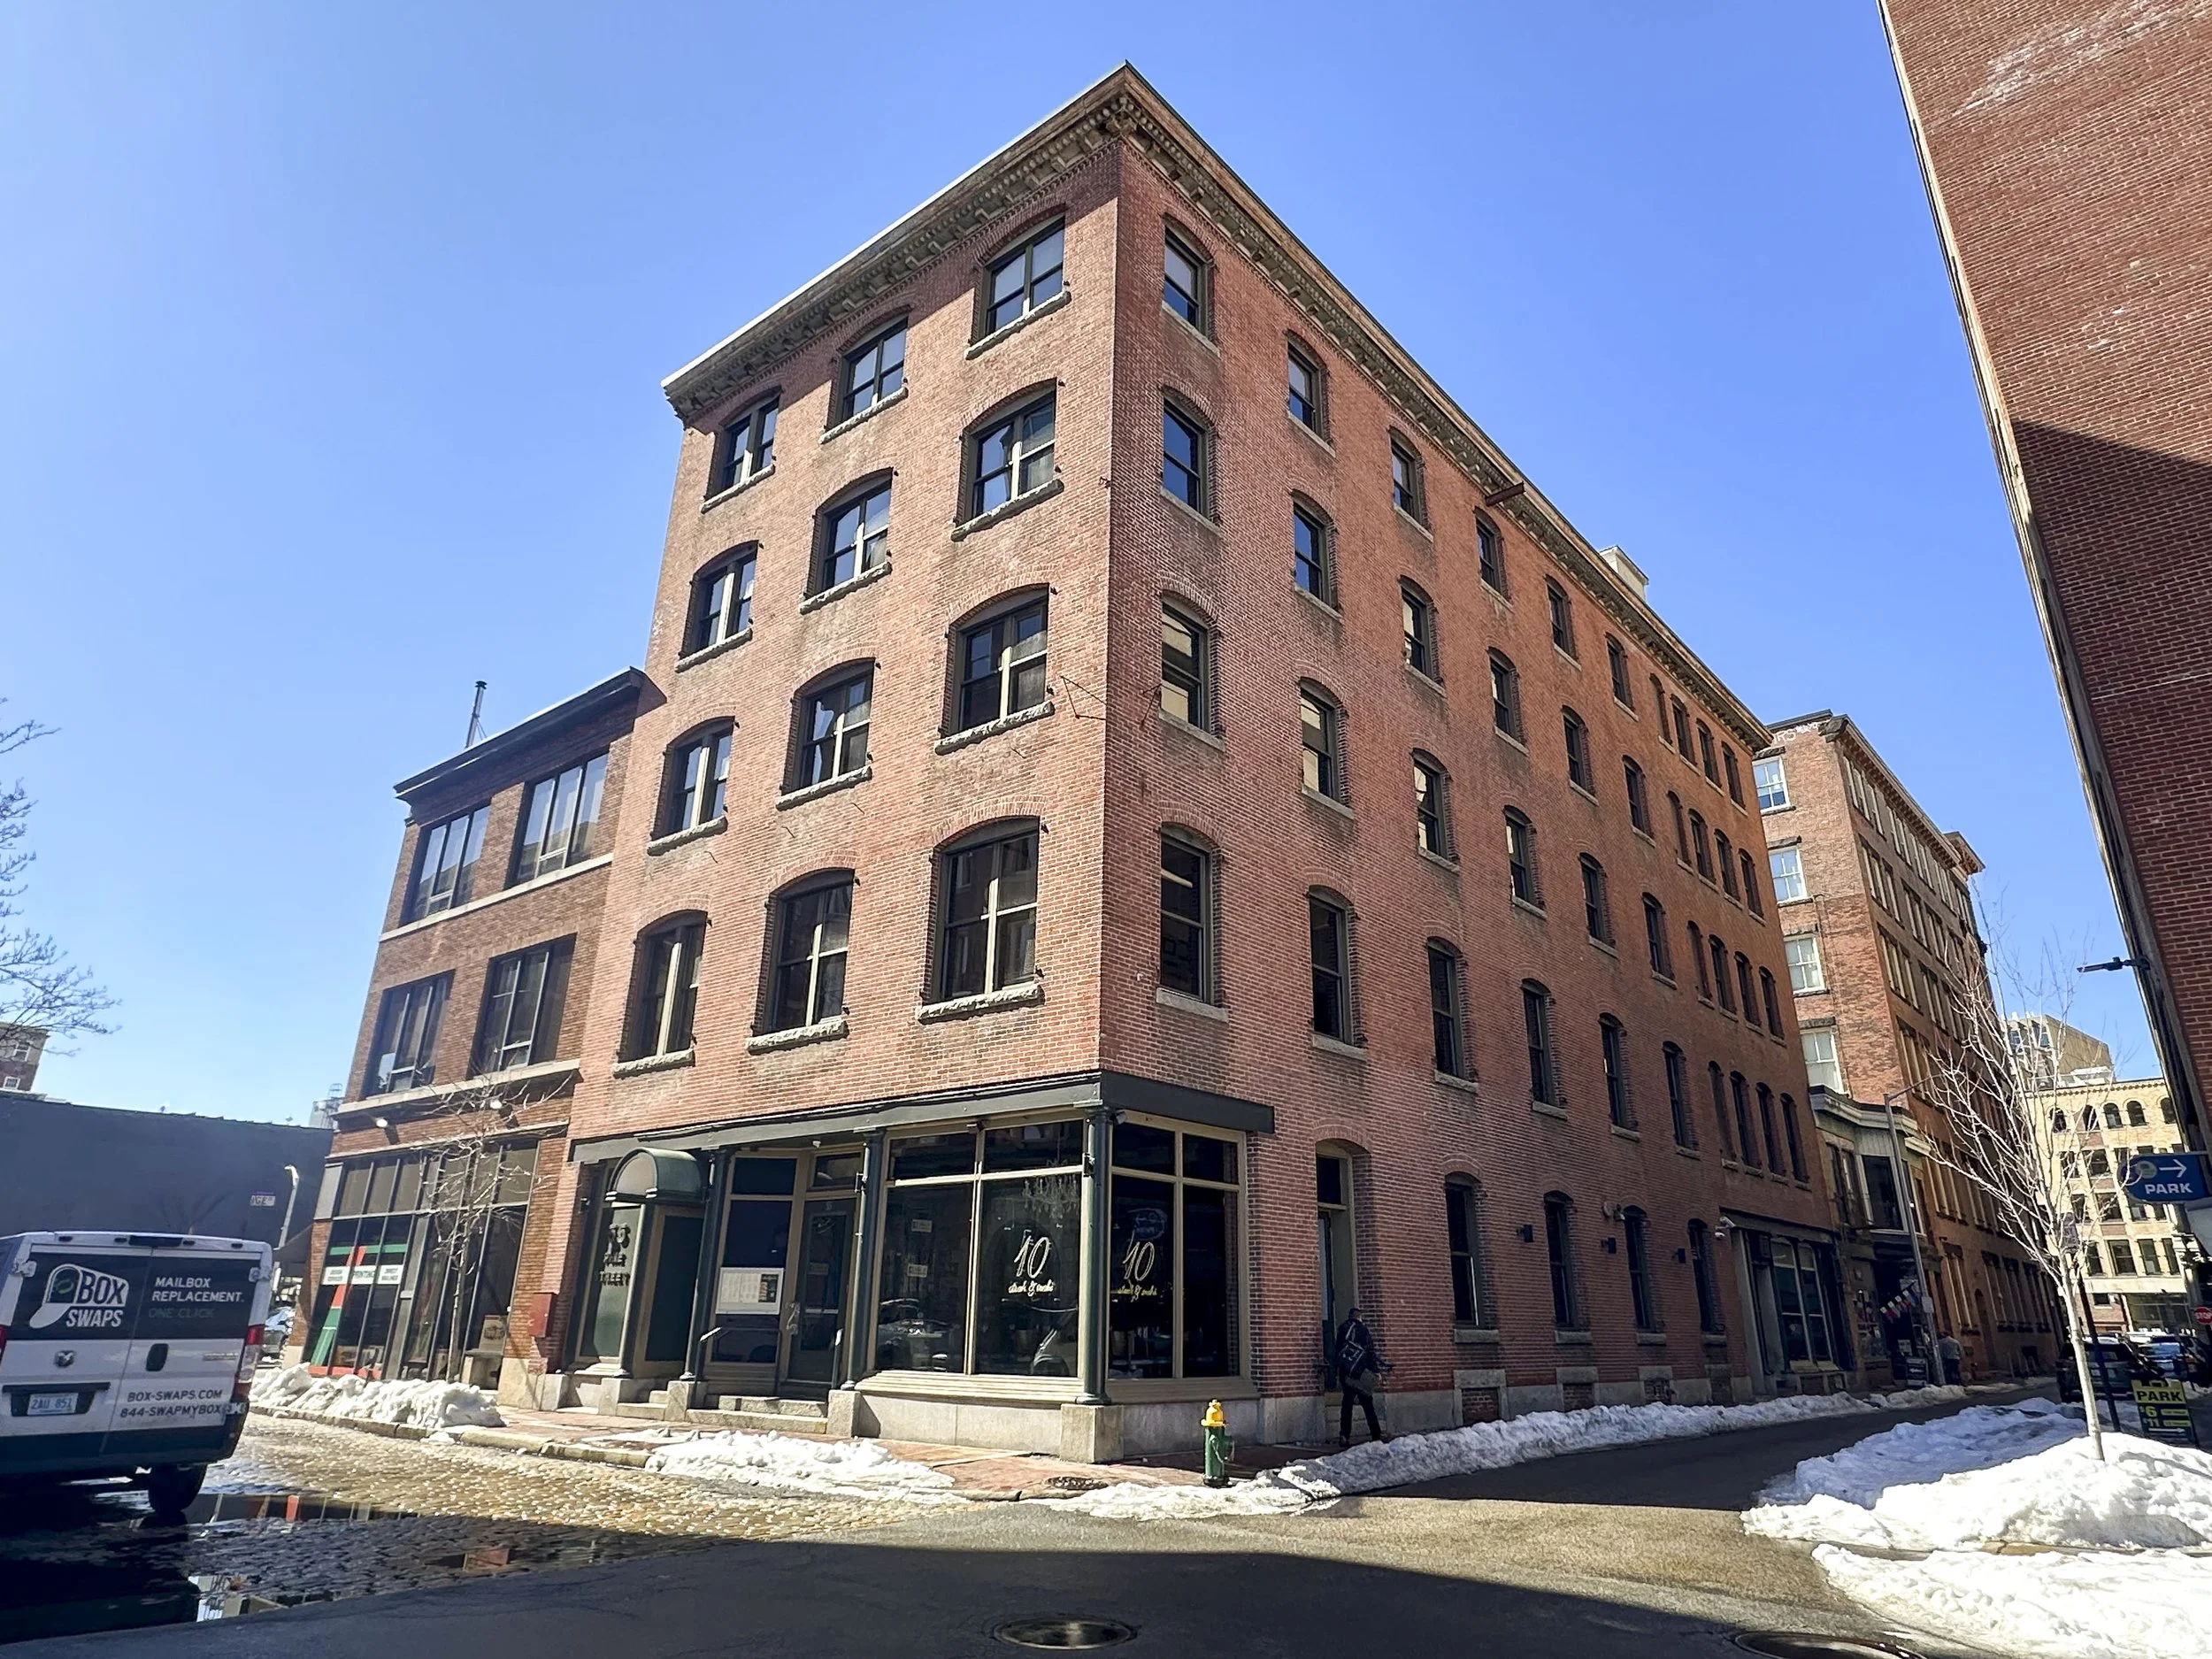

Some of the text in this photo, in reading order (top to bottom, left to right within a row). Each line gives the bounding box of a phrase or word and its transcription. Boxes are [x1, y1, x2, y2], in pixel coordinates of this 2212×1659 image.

[2145, 1183, 2193, 1194] PARK
[1014, 1236, 1049, 1279] 10
[1123, 1242, 1155, 1281] 10
[77, 1271, 126, 1304] BOX
[155, 1277, 211, 1288] MAILBOX
[151, 1291, 245, 1302] REPLACEMENT.
[65, 1310, 123, 1327] SWAPS
[148, 1308, 174, 1318] ONE
[127, 1390, 223, 1402] BOX-SWAPS.COM
[2137, 1391, 2183, 1402] PARK
[120, 1404, 220, 1417] 844-SWAPMYBOX
[2139, 1406, 2157, 1417] $6
